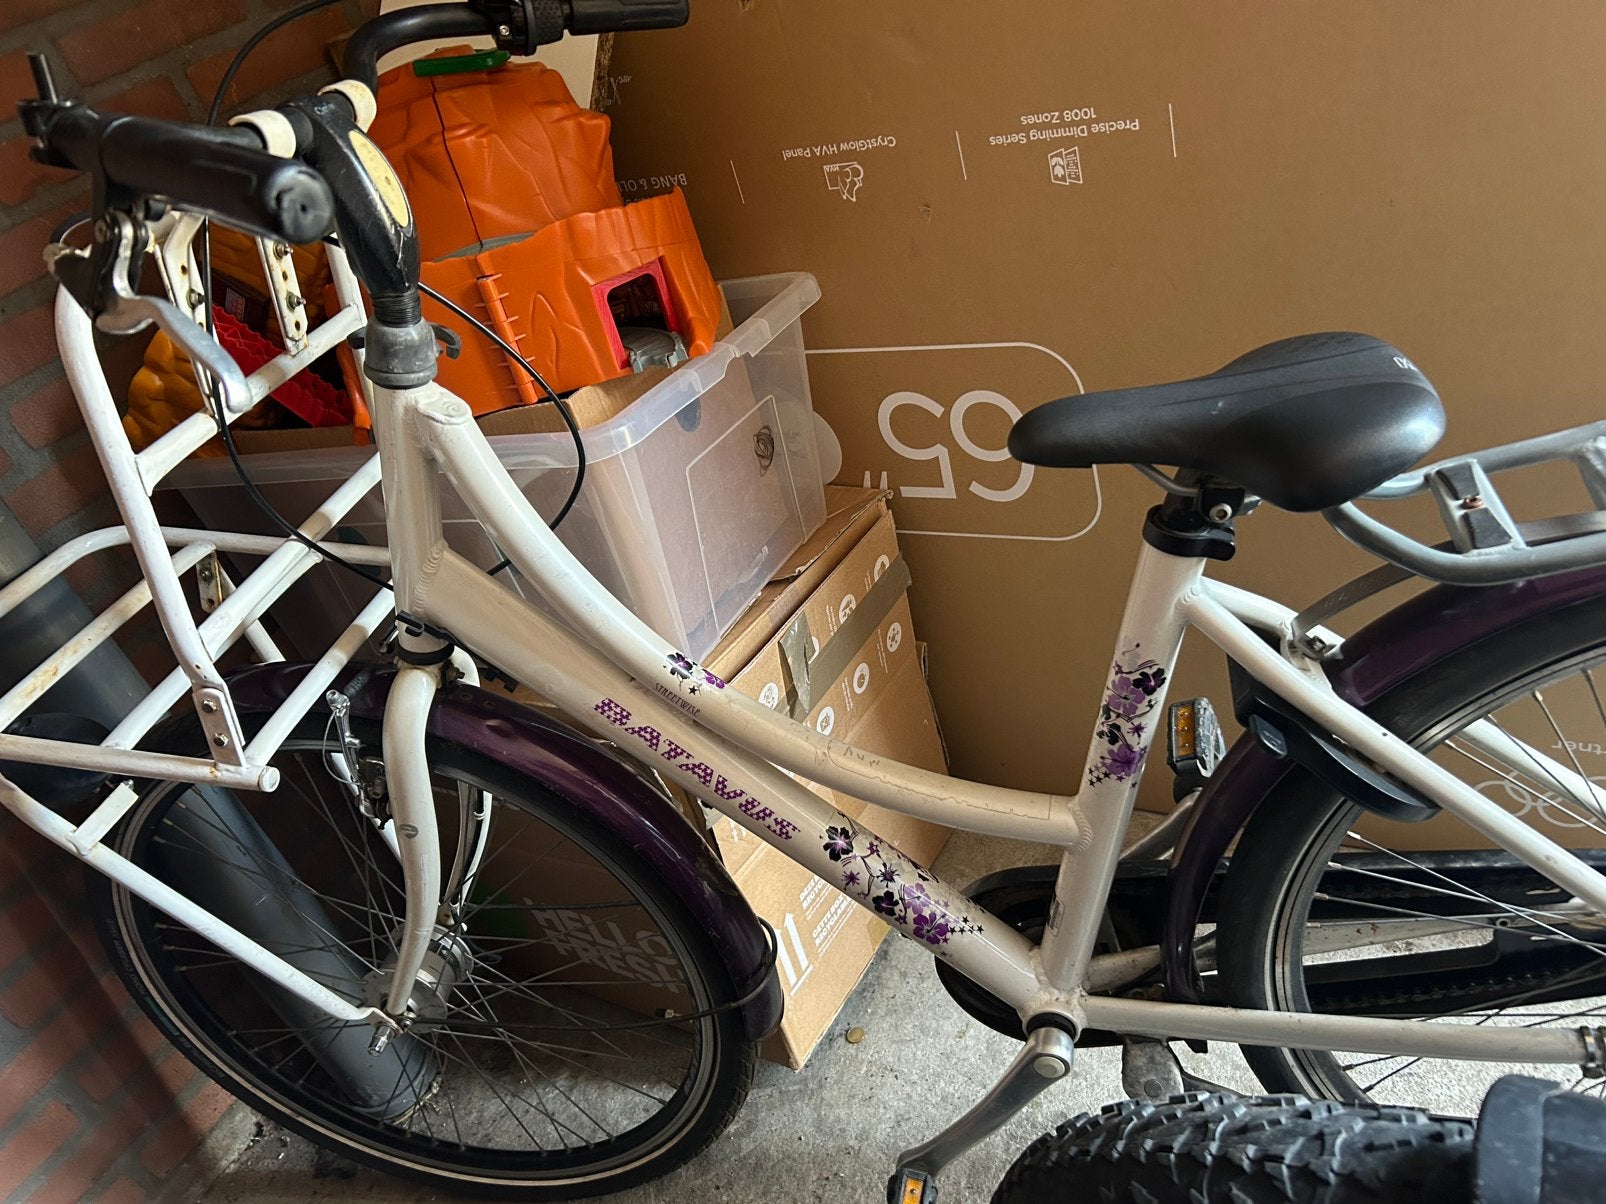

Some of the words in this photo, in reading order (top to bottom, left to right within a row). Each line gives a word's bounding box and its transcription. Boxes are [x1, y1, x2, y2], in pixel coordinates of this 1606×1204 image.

[1020, 111, 1060, 125] Zones
[1063, 106, 1097, 122] 1008
[1029, 125, 1088, 142] Dimming
[1090, 118, 1140, 134] Precise
[840, 135, 897, 152] CrystGlow
[989, 132, 1027, 146] Series
[781, 147, 811, 161] Panel
[811, 143, 838, 156] HVA
[638, 178, 647, 188] &
[650, 172, 688, 189] BANG
[653, 682, 700, 718] STREETWISE
[1551, 740, 1606, 756] tner
[593, 697, 801, 840] BATAVUS
[523, 897, 677, 966] HELLO
